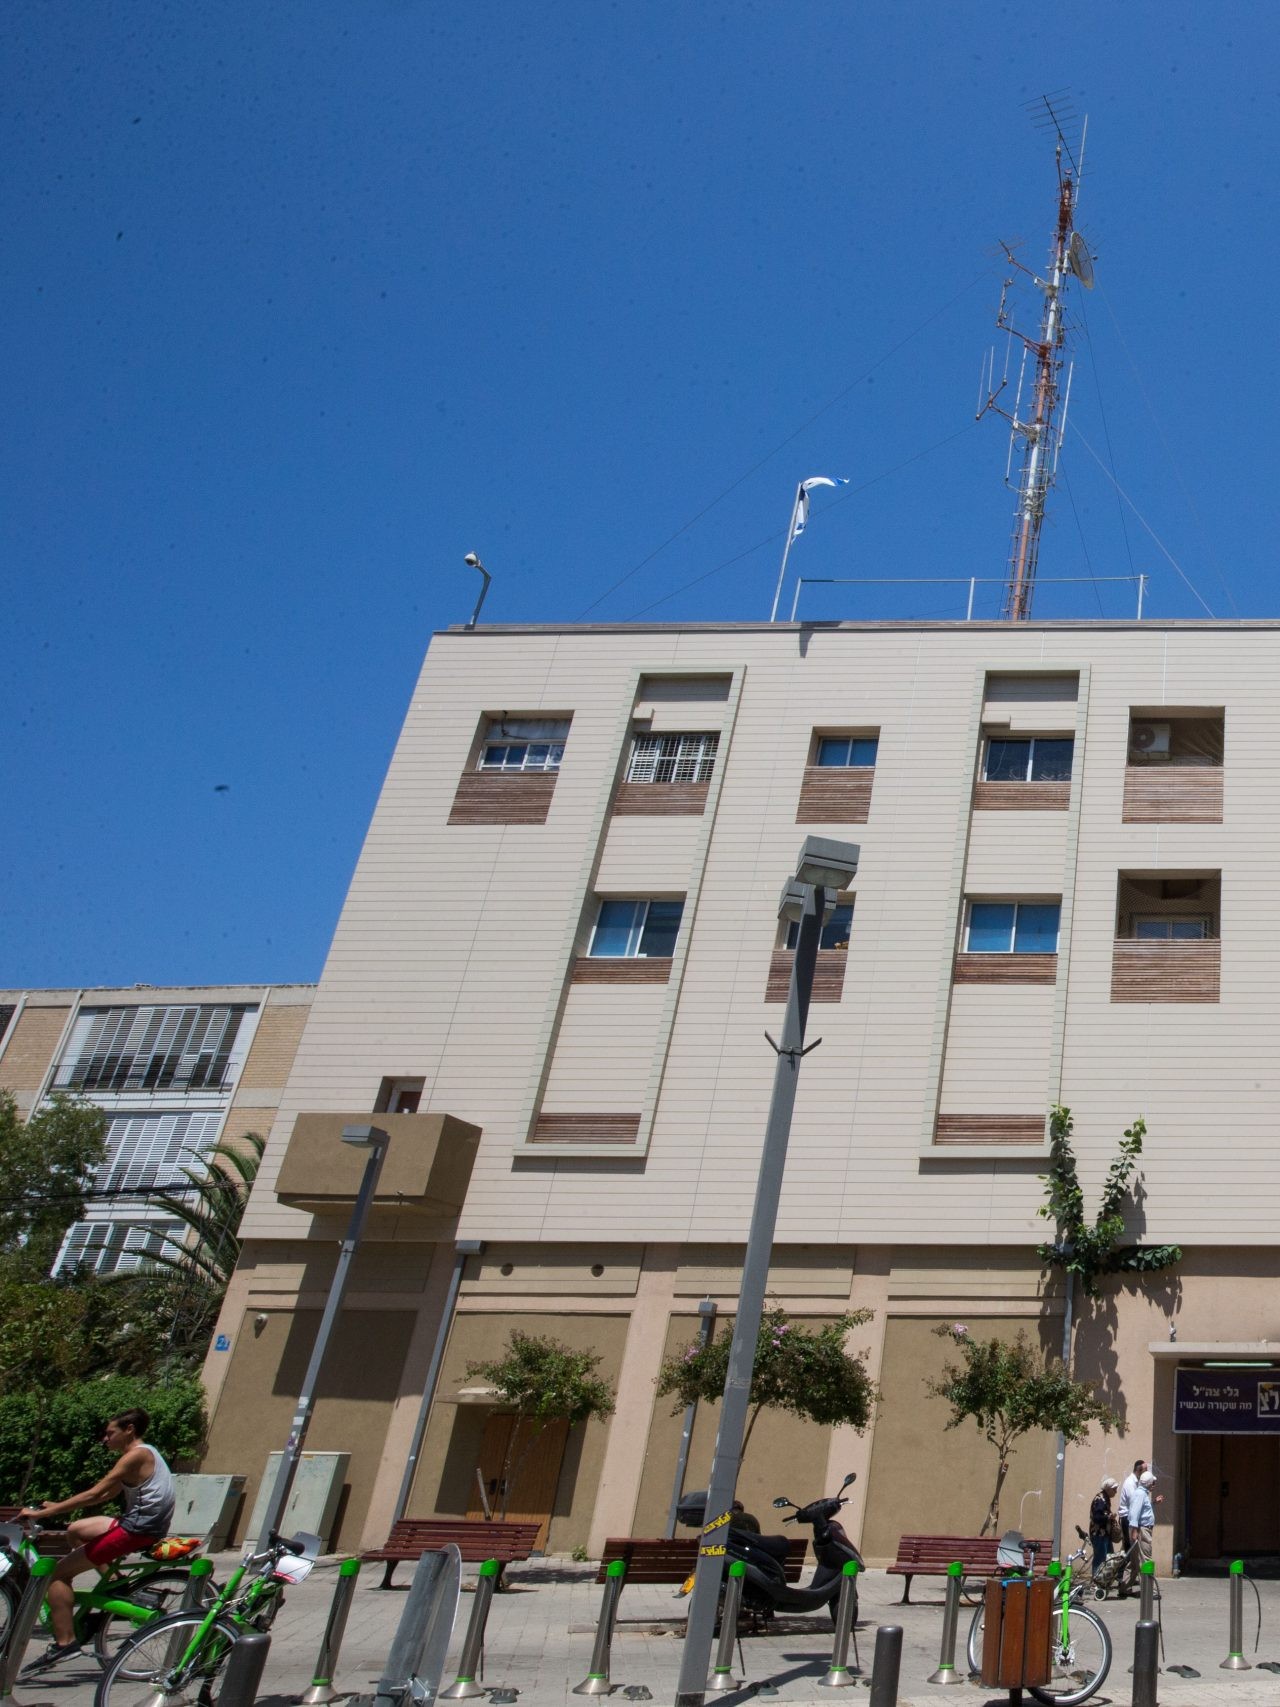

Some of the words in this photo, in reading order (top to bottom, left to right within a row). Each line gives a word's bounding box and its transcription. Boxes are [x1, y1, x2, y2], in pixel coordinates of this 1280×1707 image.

[1222, 1385, 1240, 1397] גלי
[1179, 1401, 1206, 1410] עכשיו
[1207, 1401, 1238, 1412] שקורה
[1239, 1401, 1252, 1410] מה
